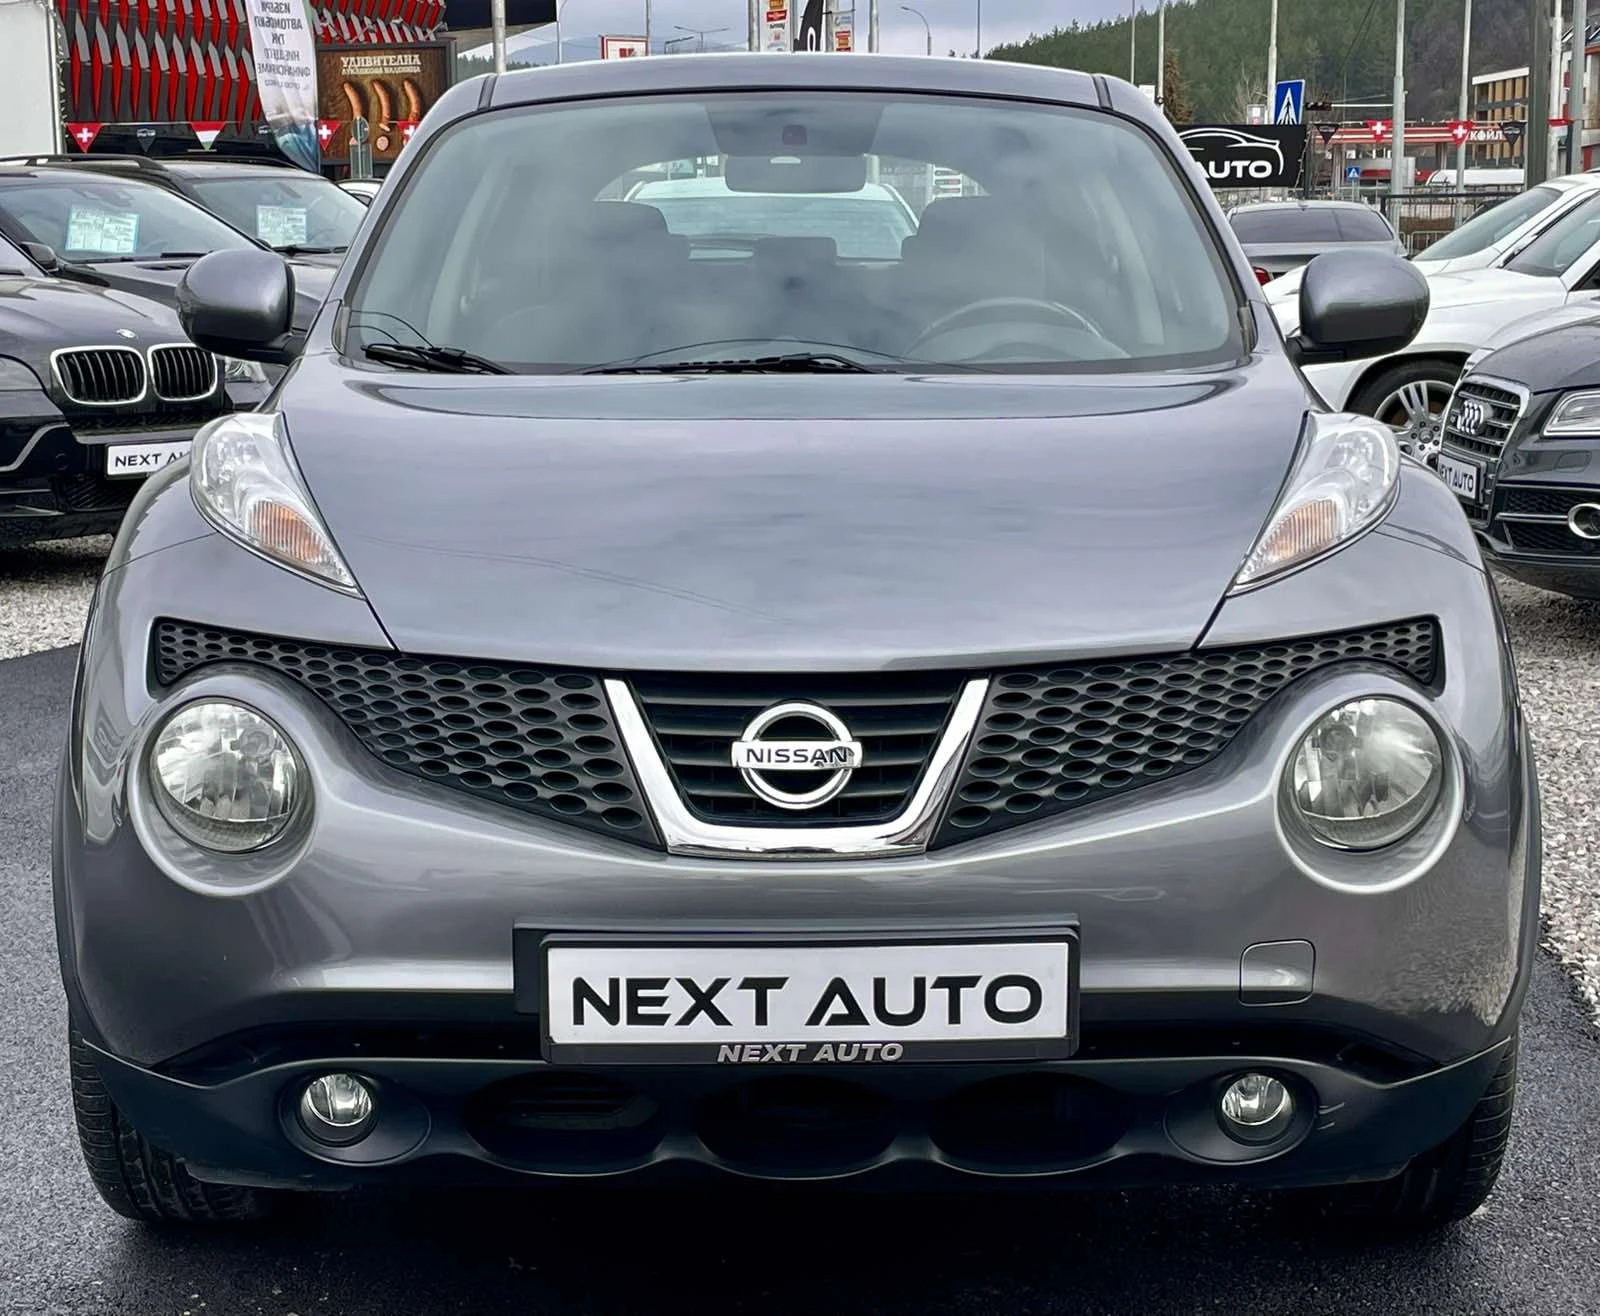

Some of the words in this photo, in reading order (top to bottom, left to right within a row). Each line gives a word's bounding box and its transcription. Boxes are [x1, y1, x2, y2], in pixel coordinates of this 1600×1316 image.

[115, 453, 162, 467] NEXT
[746, 748, 848, 763] NISSAN
[572, 977, 790, 1027] NEXT
[805, 974, 1043, 1026] AUTO
[716, 1043, 807, 1063] NEXT
[813, 1042, 904, 1062] AUTO
